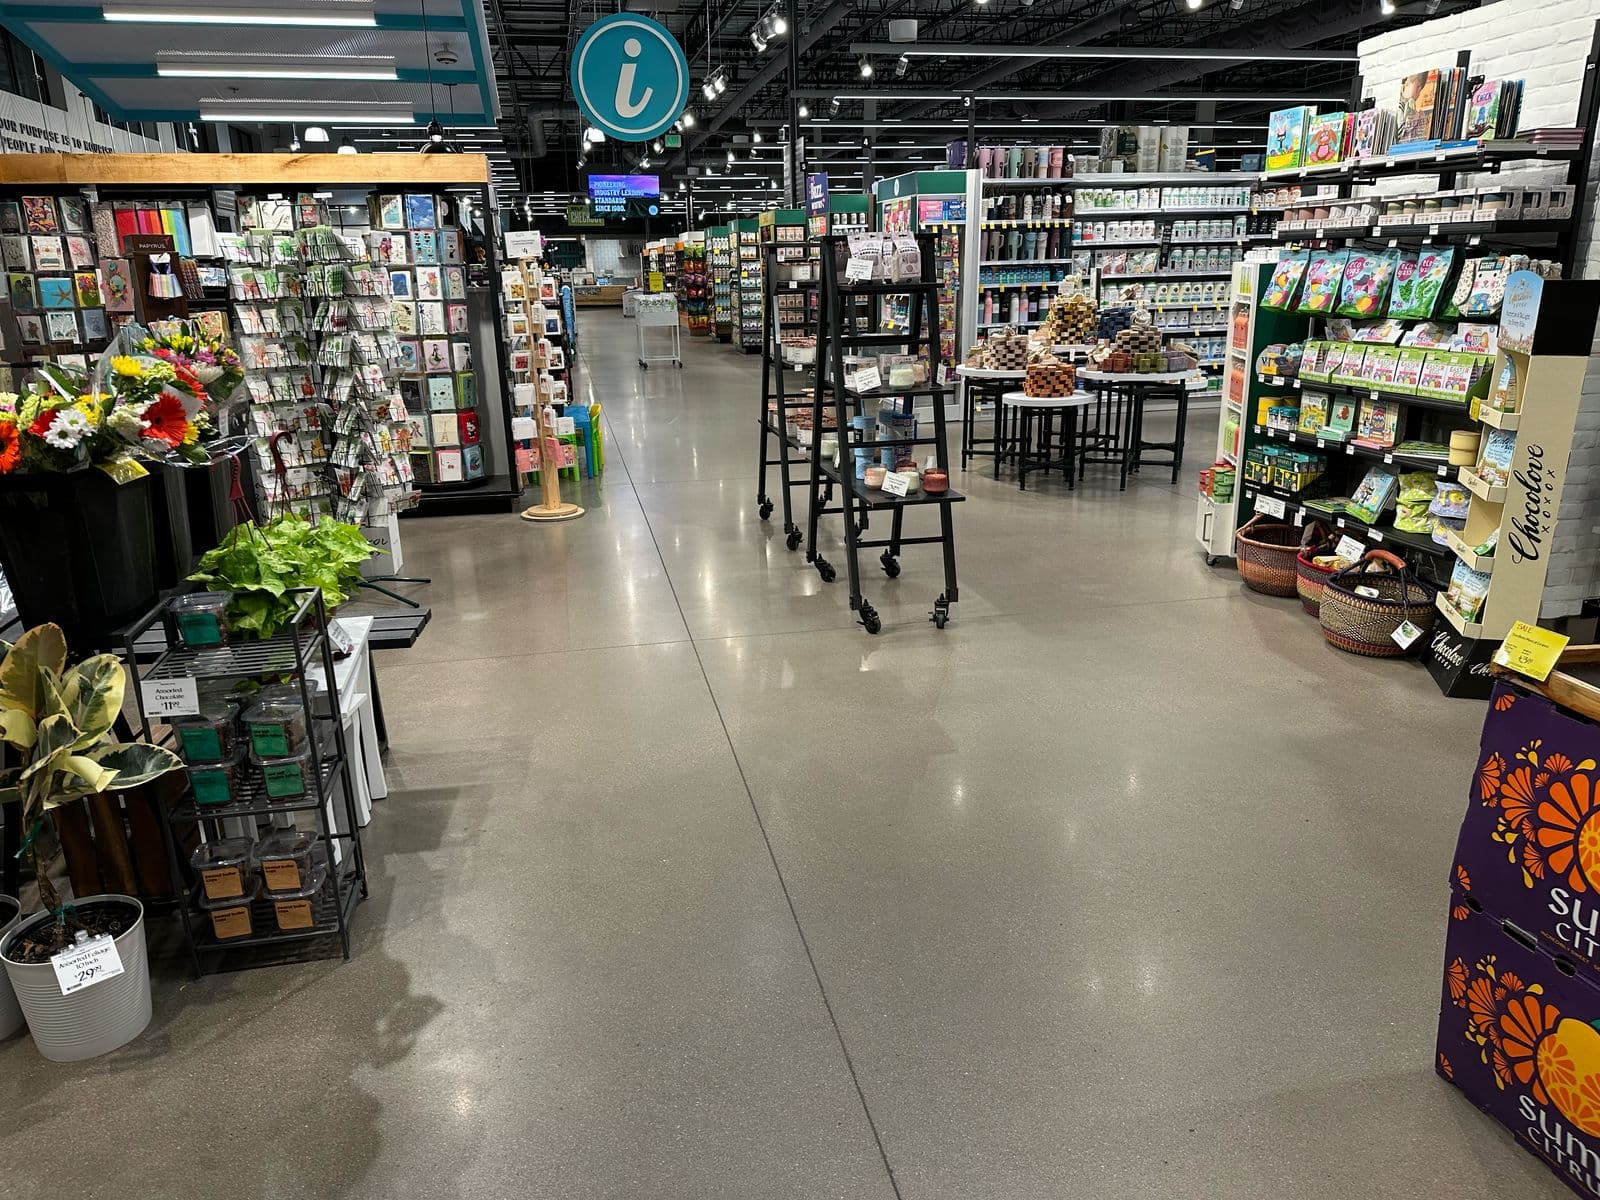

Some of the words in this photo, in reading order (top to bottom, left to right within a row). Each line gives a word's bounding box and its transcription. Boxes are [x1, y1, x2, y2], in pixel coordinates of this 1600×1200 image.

[964, 97, 970, 106] 3
[1, 136, 36, 153] PEOPLE
[20, 123, 60, 143] PURPOSE
[61, 135, 71, 146] IS
[71, 137, 82, 149] TO
[1508, 444, 1544, 564] Chocolove
[1431, 631, 1464, 667] Chocolove
